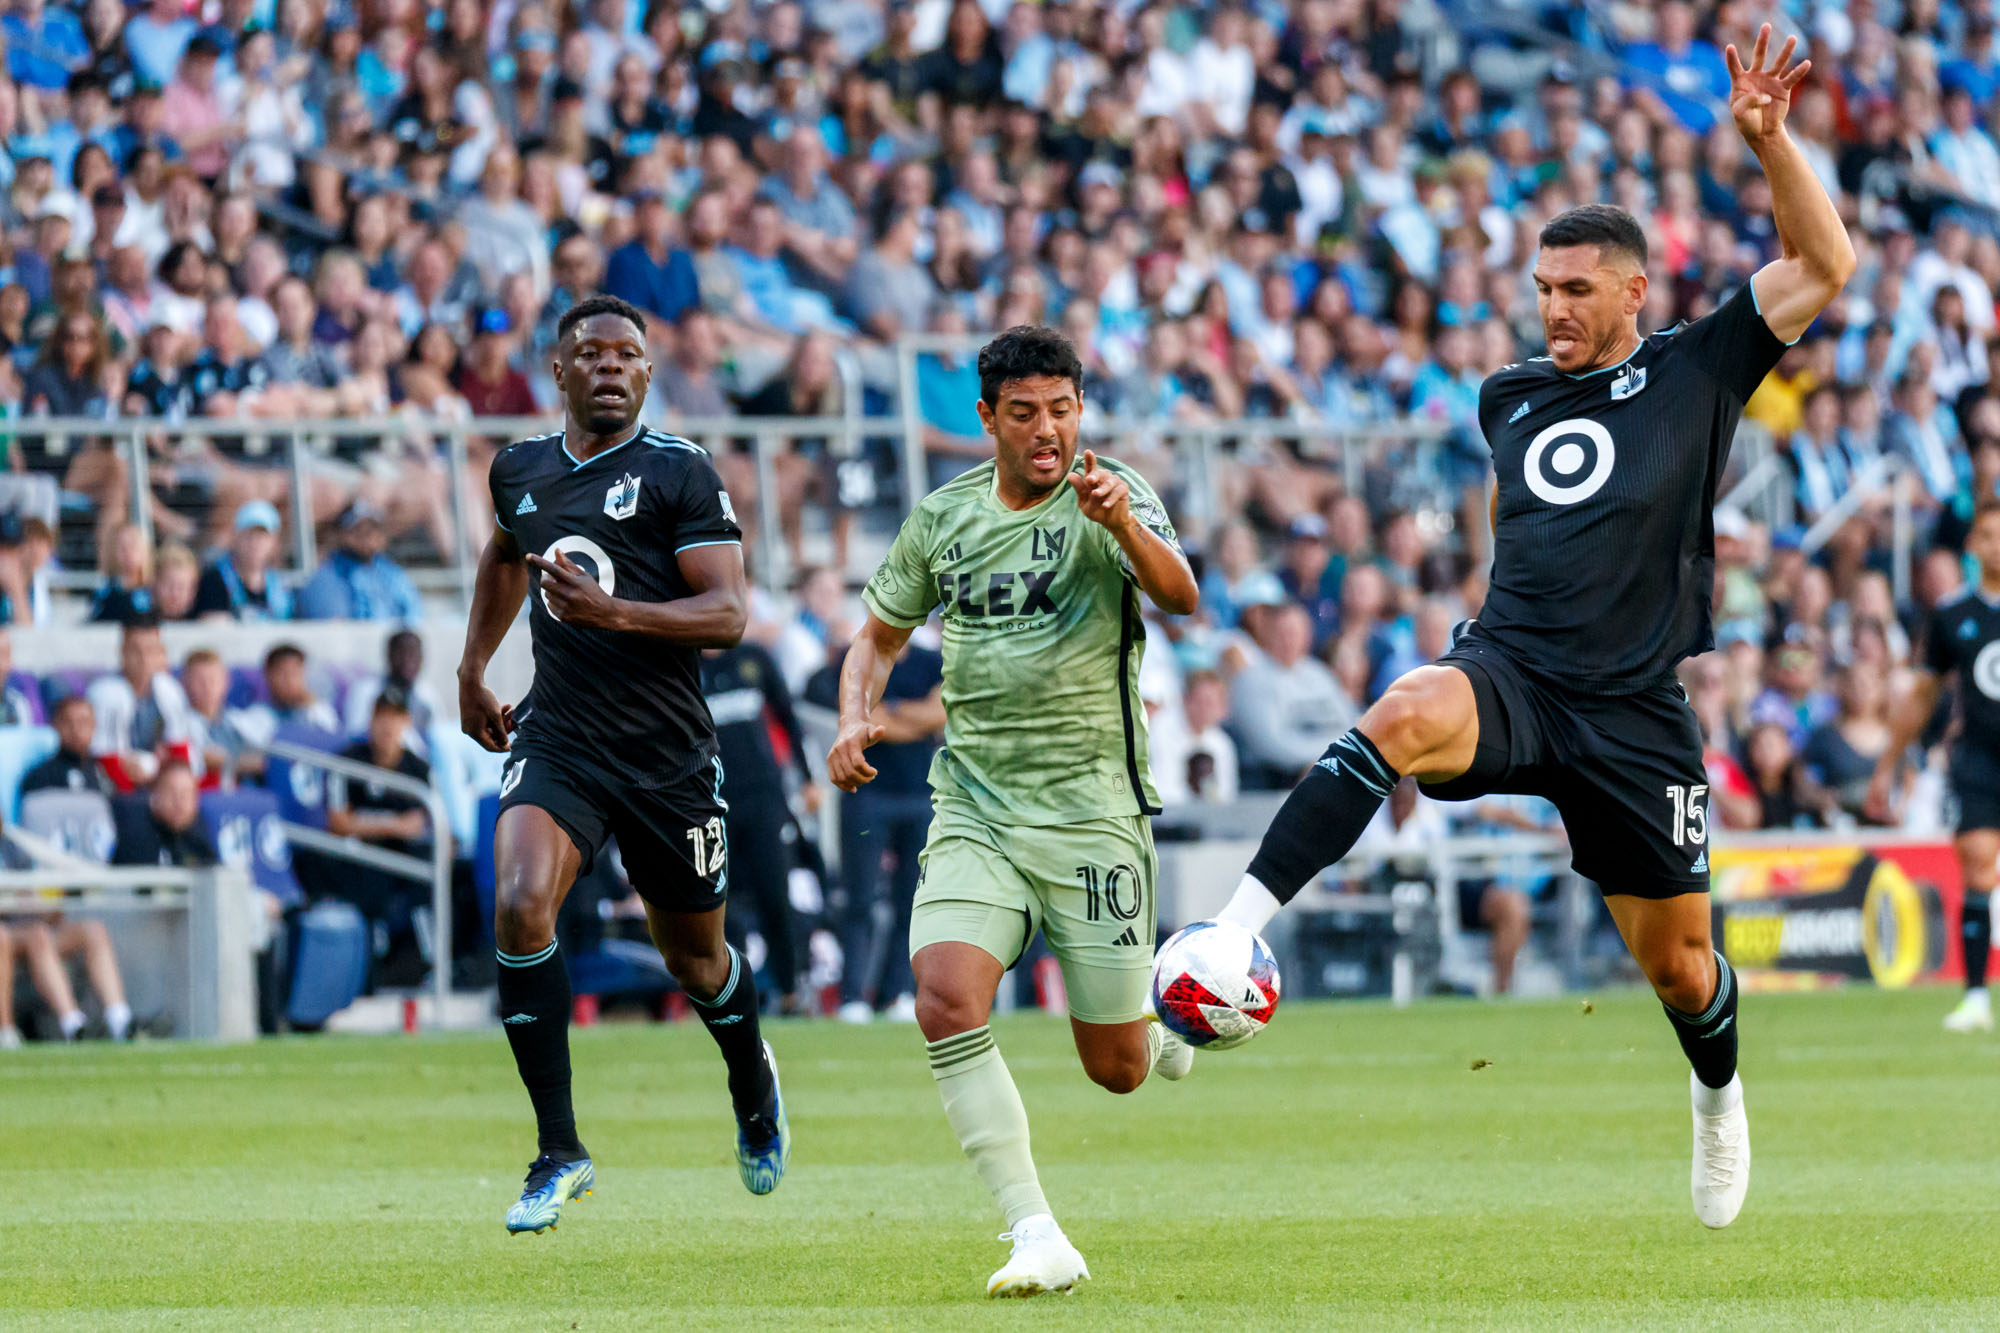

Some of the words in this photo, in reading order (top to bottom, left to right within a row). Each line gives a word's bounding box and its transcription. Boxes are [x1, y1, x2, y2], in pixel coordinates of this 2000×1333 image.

[937, 571, 1059, 616] FLEX
[997, 621, 1046, 632] TOOLS
[1666, 784, 1709, 846] 15
[686, 816, 726, 877] 12
[1076, 863, 1142, 922] 10
